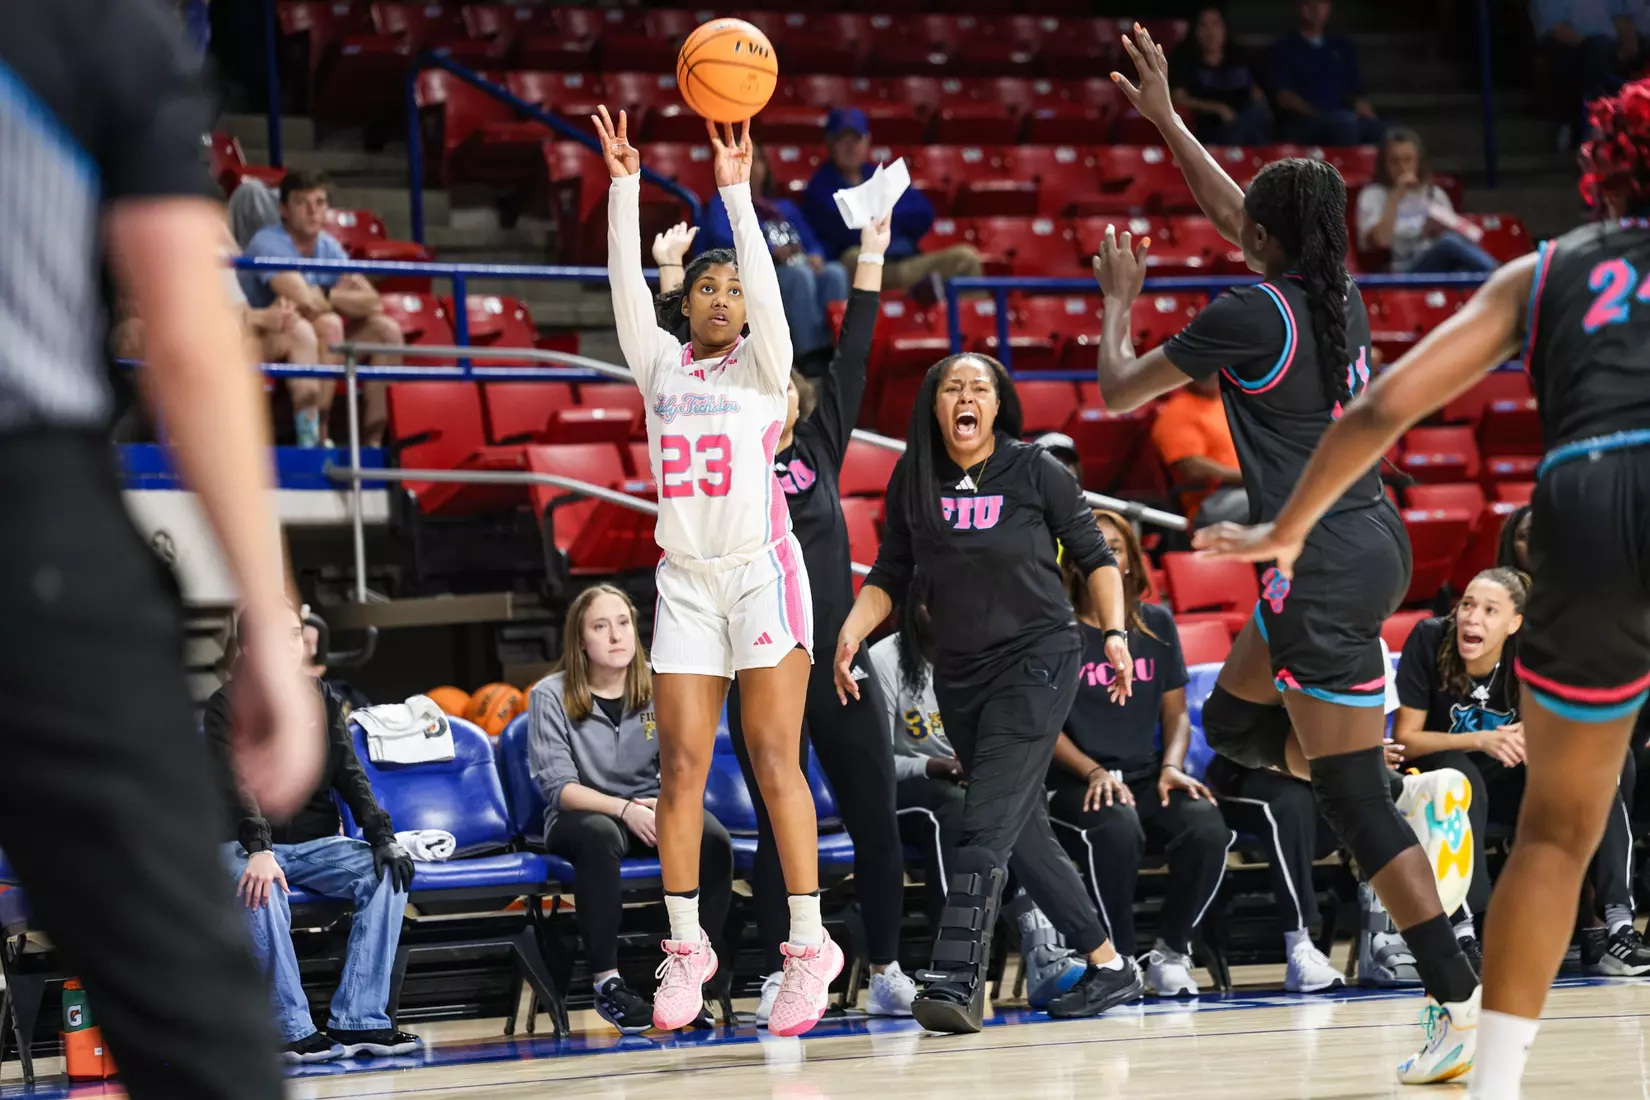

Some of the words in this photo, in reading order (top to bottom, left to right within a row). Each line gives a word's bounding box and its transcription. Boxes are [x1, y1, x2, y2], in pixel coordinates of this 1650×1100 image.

[1582, 256, 1650, 335] 2
[660, 434, 732, 498] 23
[940, 495, 1003, 530] FIU
[67, 1004, 83, 1027] G
